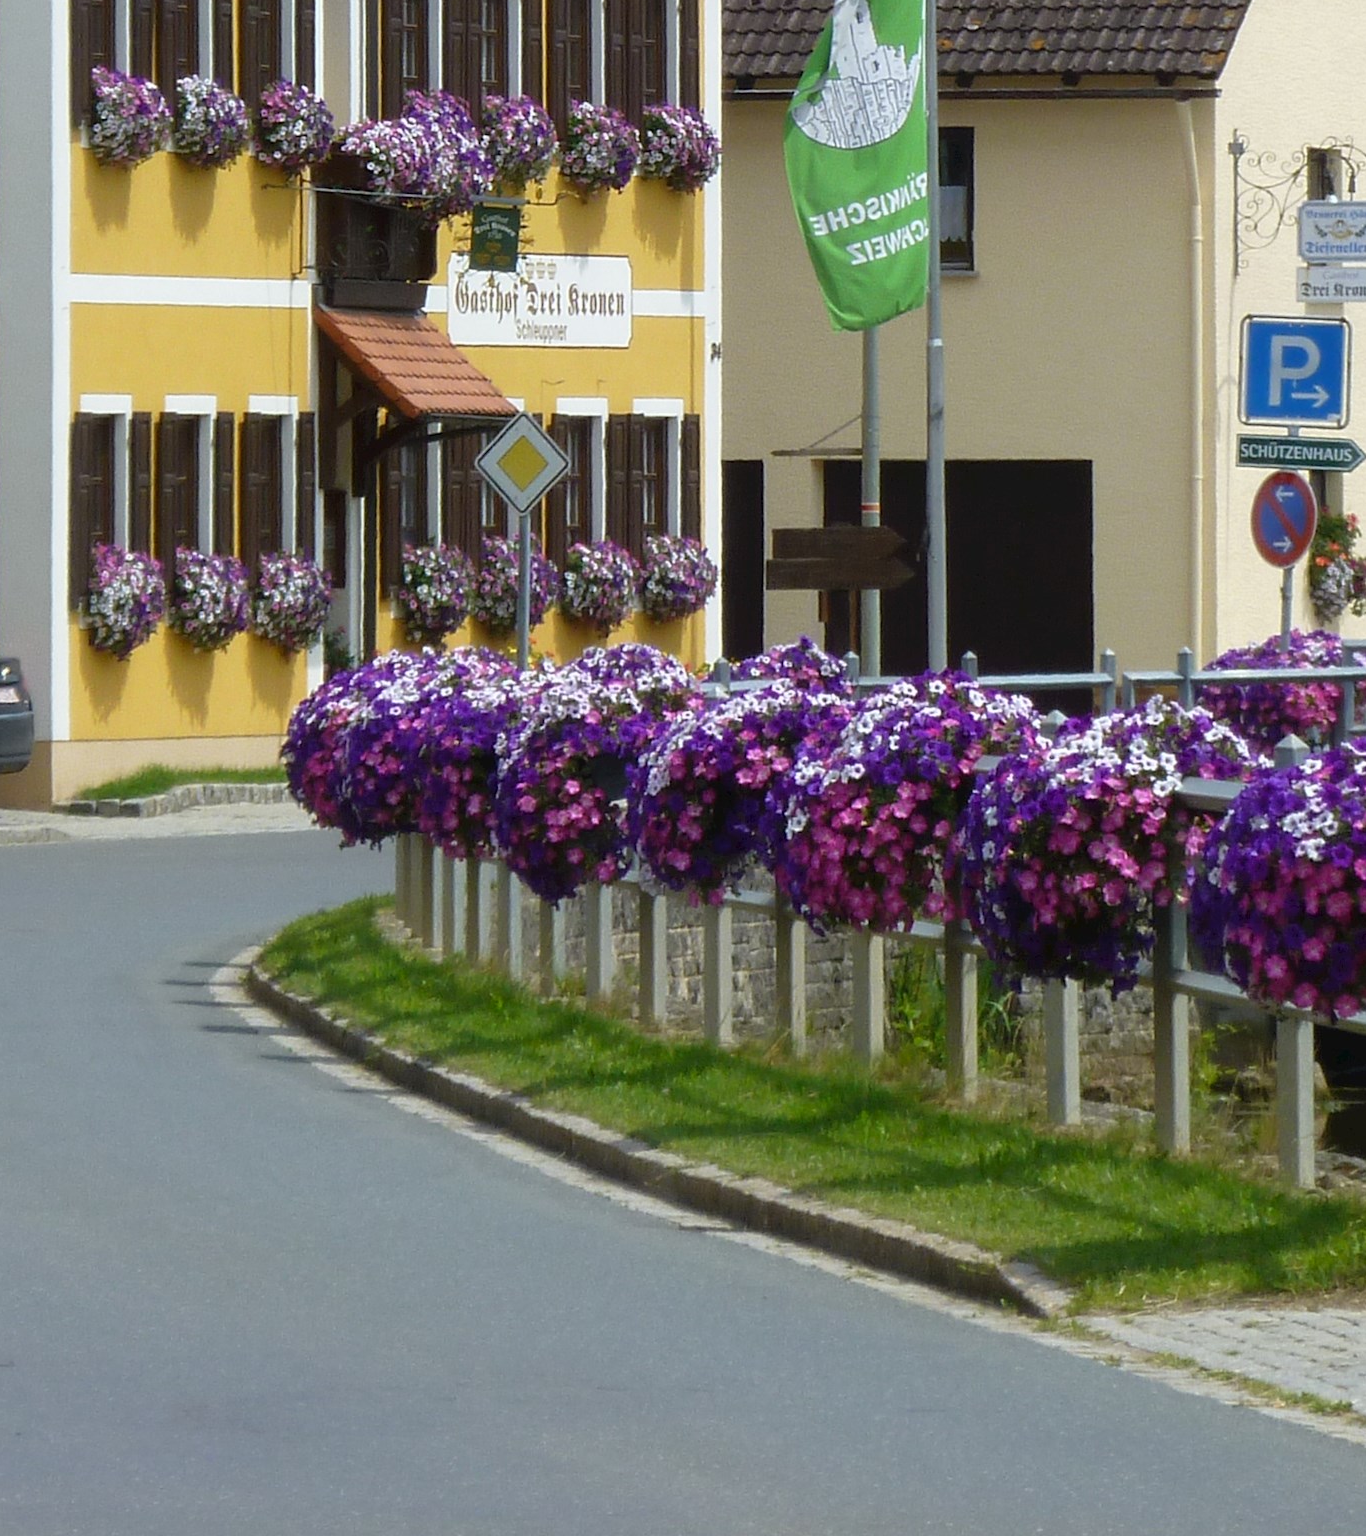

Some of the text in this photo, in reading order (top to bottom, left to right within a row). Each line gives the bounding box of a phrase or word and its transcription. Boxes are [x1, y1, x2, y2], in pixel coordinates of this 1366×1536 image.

[455, 277, 625, 324] Gasthof Drei Kronen
[1300, 281, 1330, 297] Drei
[516, 318, 568, 344] Schleuppner
[1268, 335, 1321, 406] P
[1240, 442, 1353, 462] SCHÜTZENHAUS
